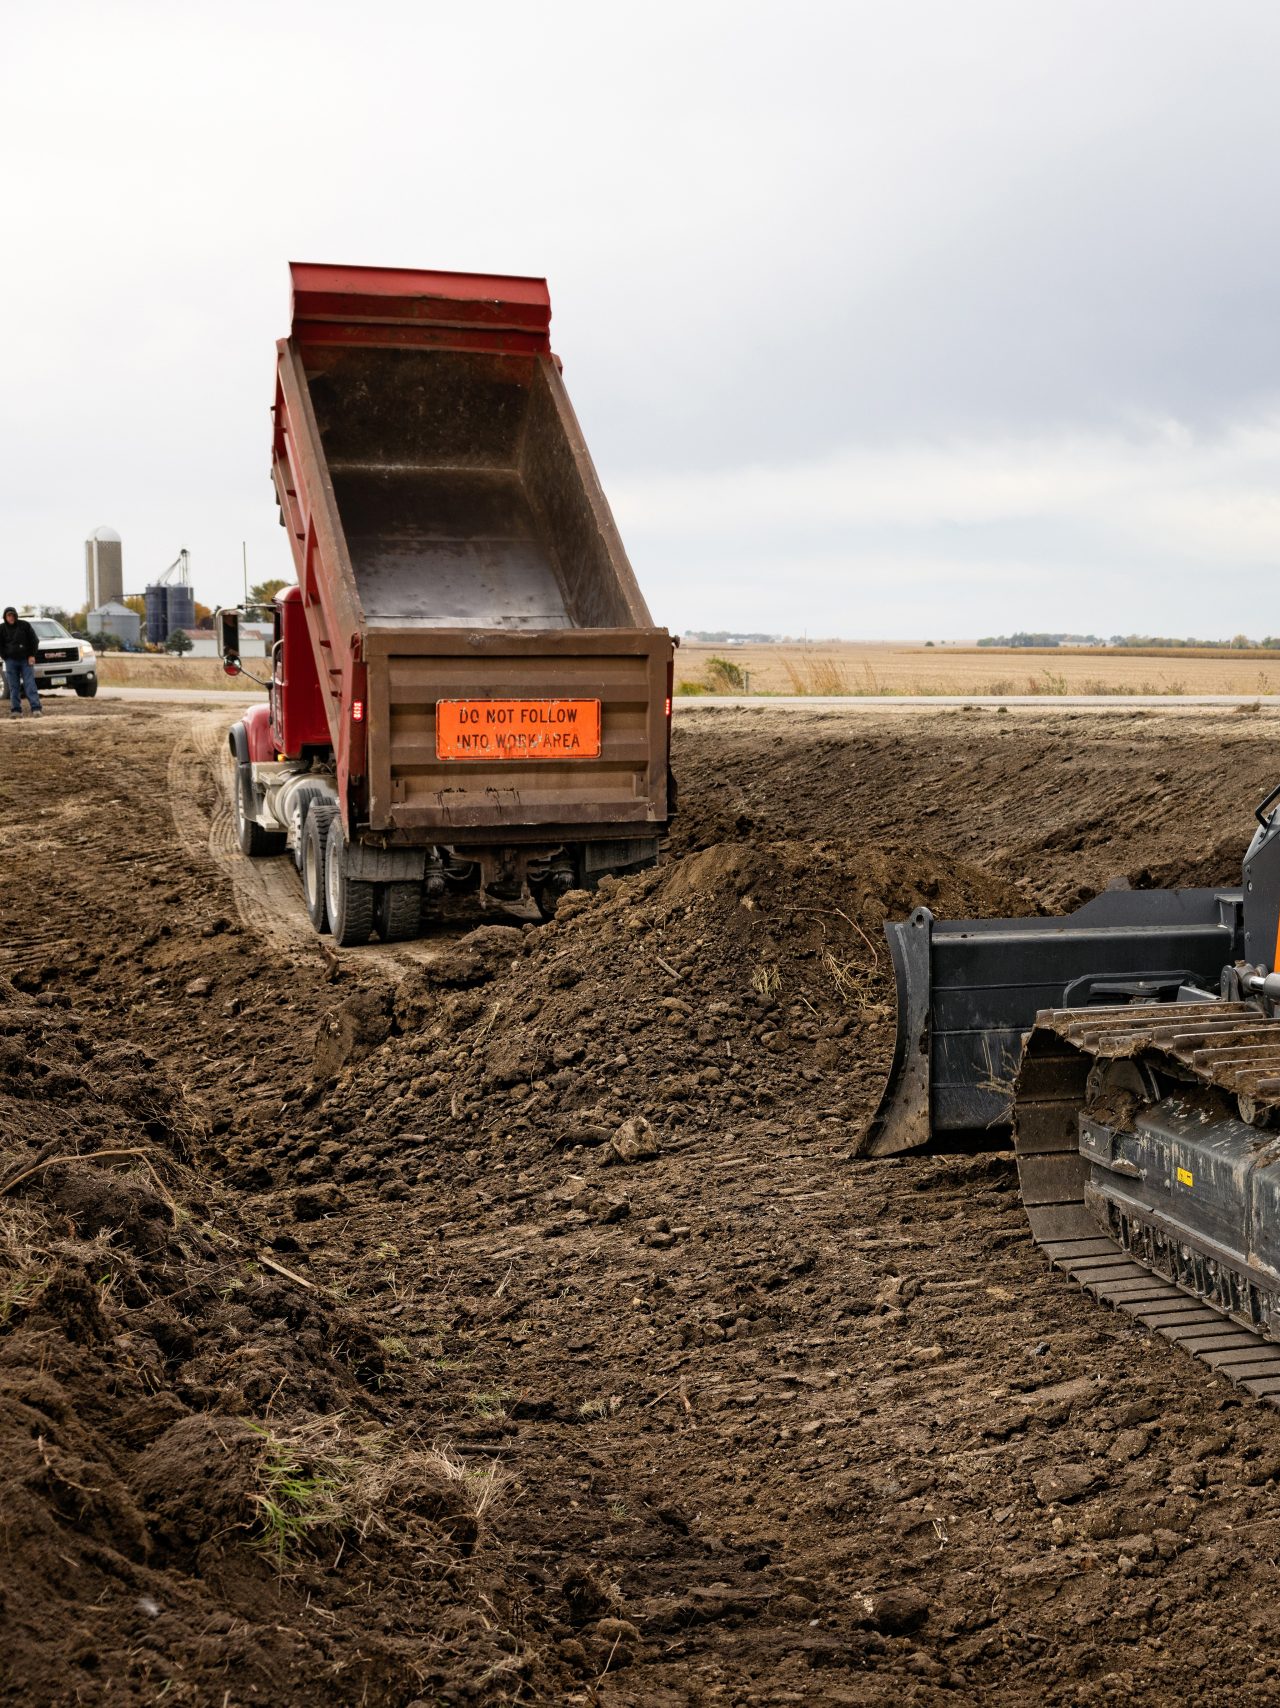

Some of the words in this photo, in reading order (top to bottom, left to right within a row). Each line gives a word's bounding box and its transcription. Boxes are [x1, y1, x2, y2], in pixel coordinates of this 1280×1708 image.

[459, 709, 479, 724] DO
[486, 709, 514, 724] NOT
[520, 709, 578, 724] FOLLOW
[456, 734, 489, 749] INTO
[495, 734, 538, 749] WORK
[543, 733, 580, 748] AREA
